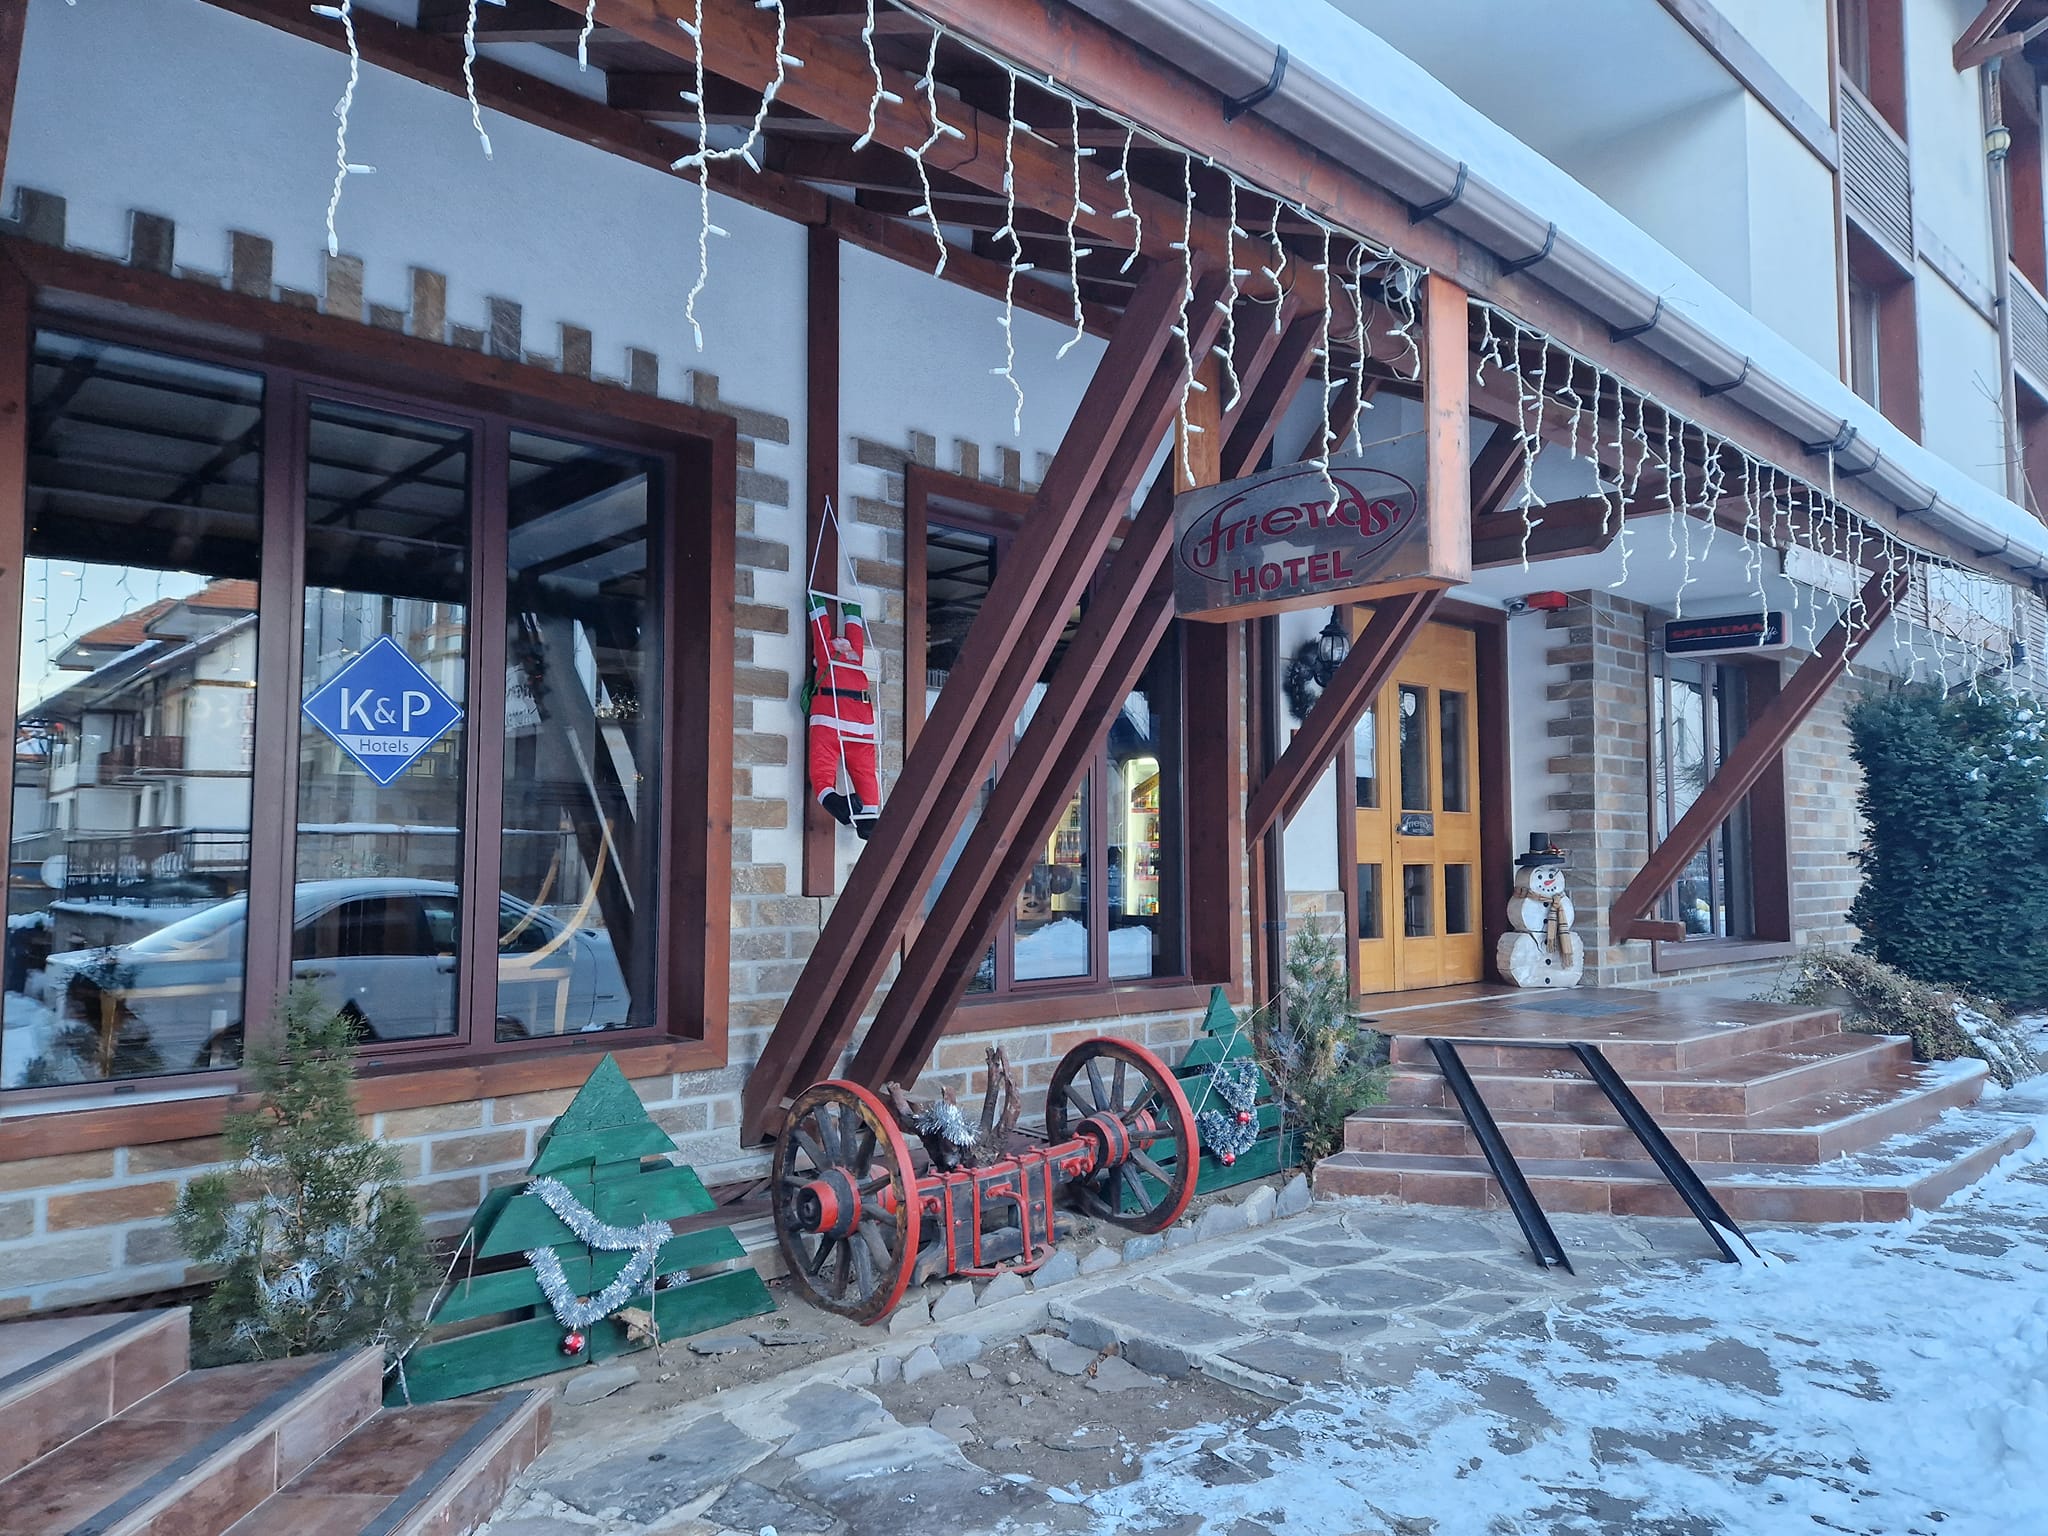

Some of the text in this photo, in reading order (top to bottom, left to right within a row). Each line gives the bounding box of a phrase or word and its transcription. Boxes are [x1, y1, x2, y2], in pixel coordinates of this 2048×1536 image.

[1233, 550, 1353, 596] HOTEL
[340, 687, 431, 732] K&P
[359, 739, 409, 752] Hotels
